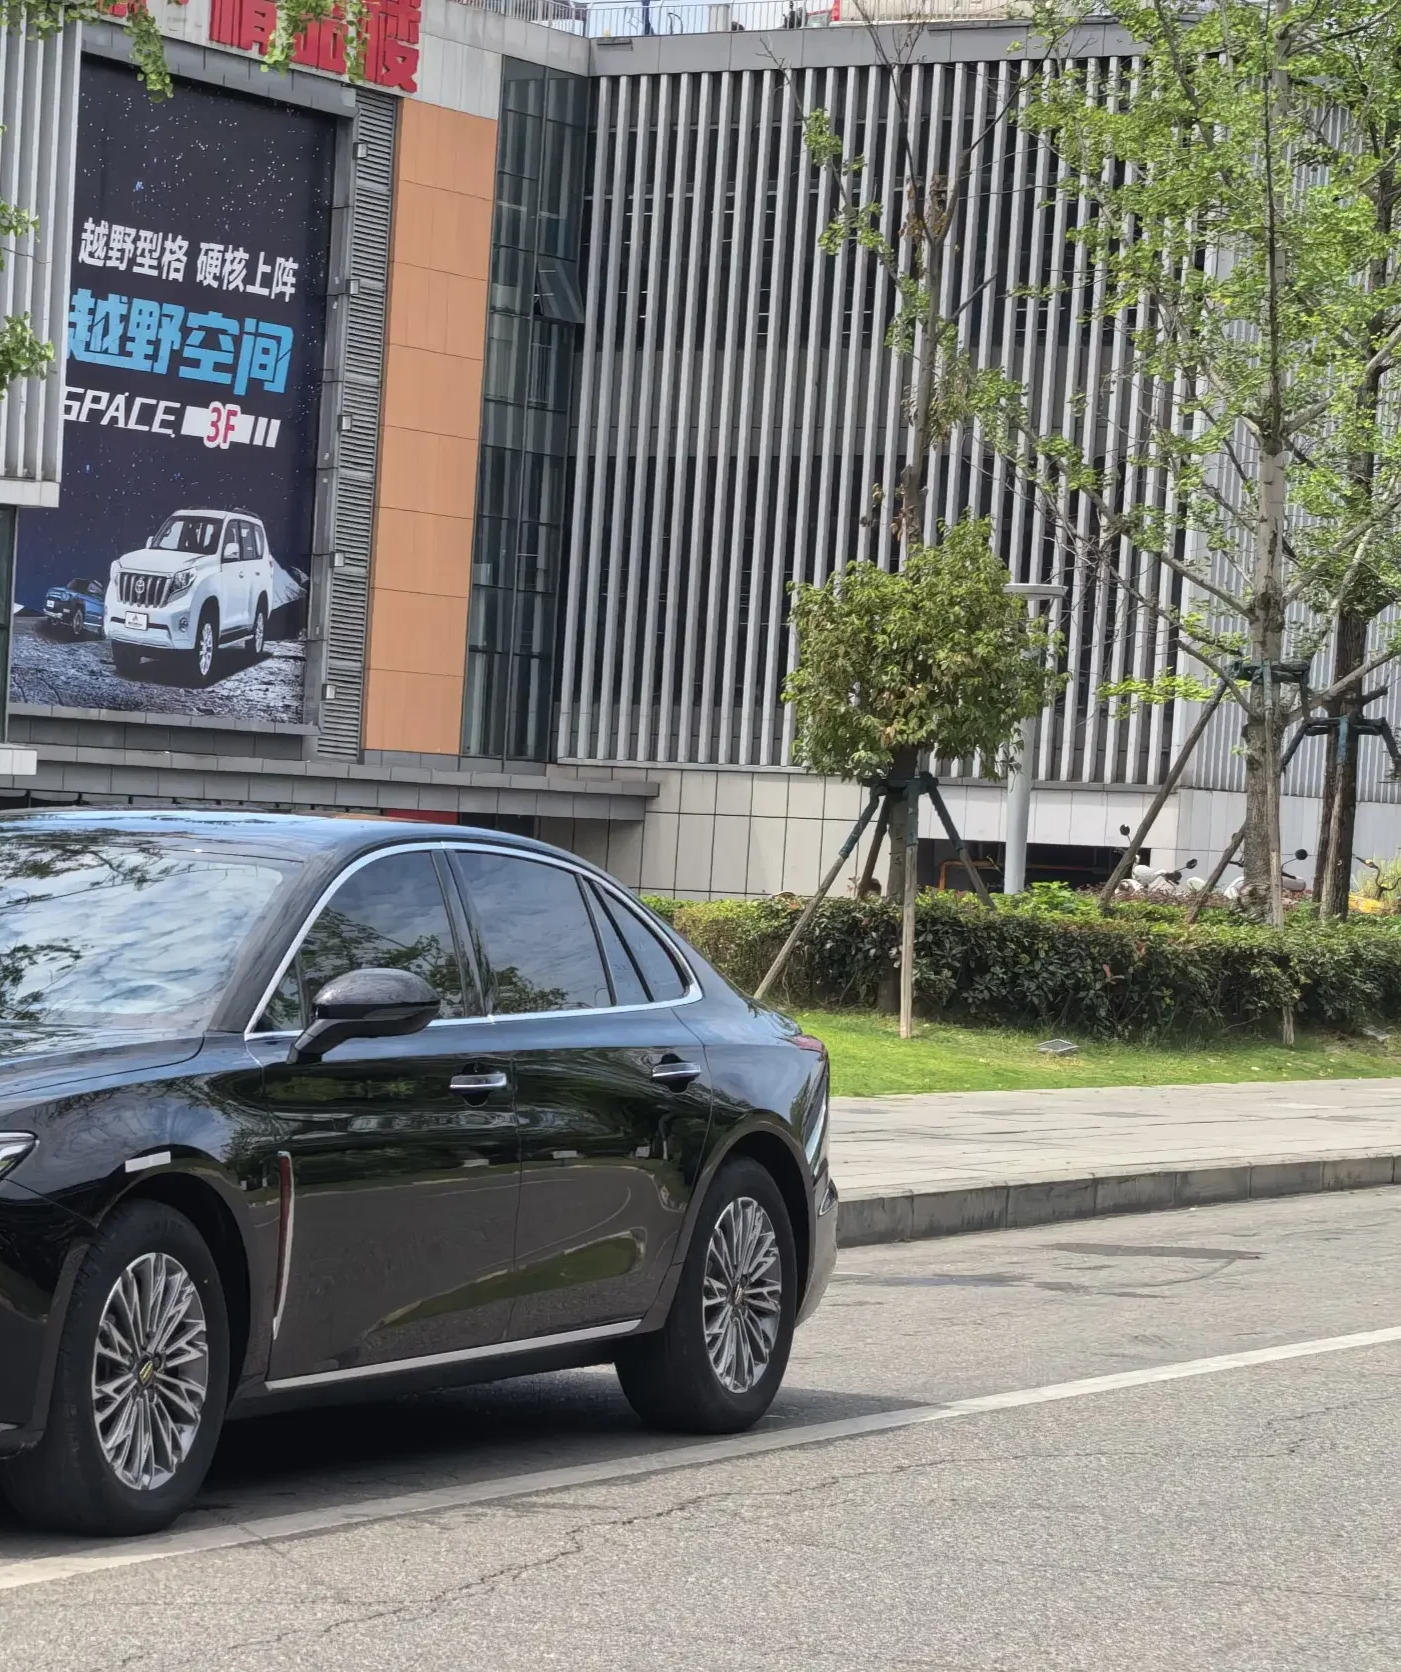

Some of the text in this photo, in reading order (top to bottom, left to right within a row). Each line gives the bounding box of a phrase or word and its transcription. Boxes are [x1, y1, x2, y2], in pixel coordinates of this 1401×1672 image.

[78, 217, 299, 302] 越野型格 硬核上阵
[66, 288, 294, 396] 越野空间
[63, 386, 239, 445] SPACE 3F
